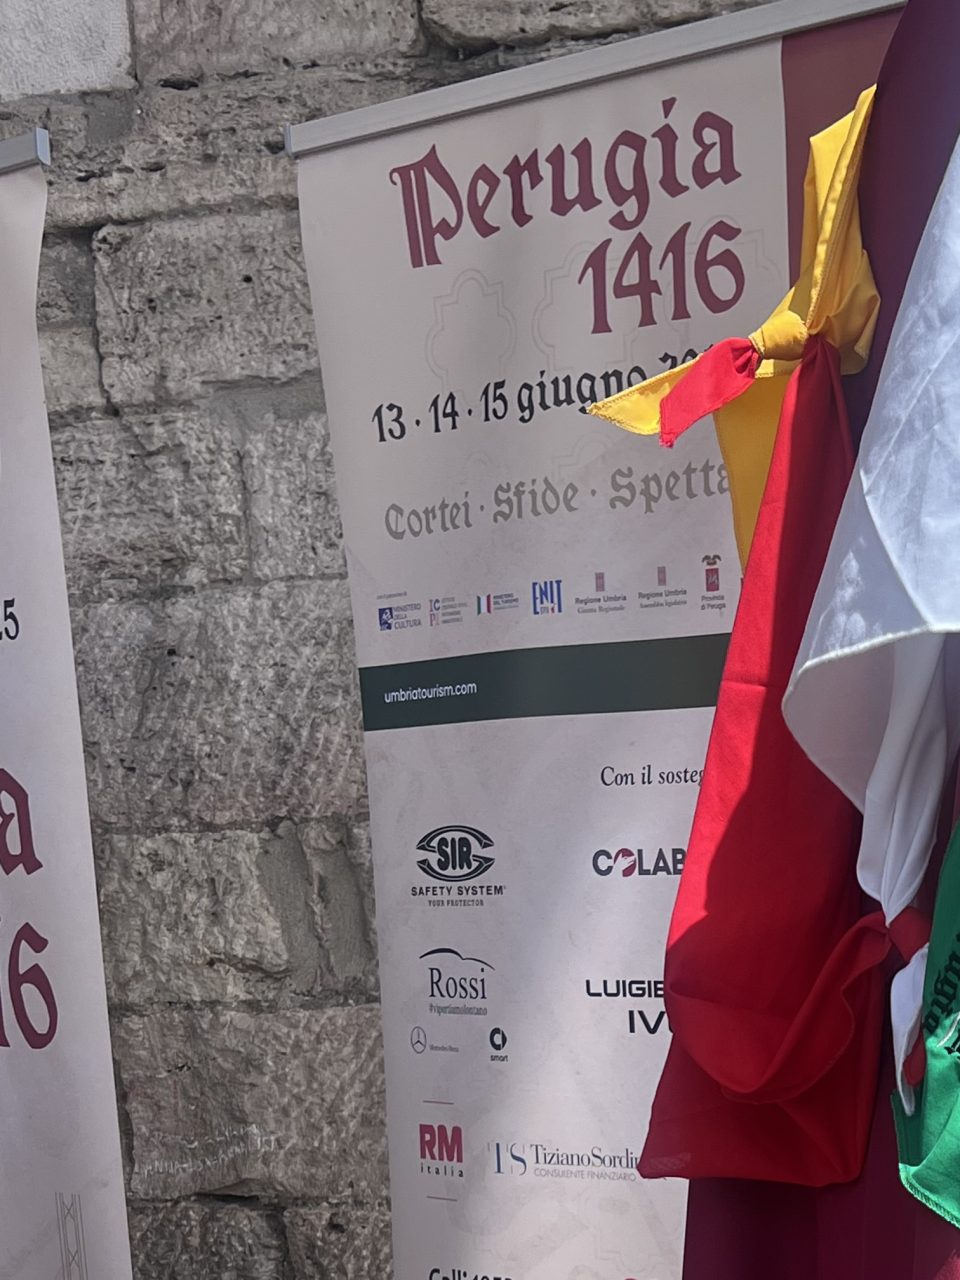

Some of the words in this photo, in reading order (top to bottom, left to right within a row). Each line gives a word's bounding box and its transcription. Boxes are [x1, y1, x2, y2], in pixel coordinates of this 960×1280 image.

[389, 97, 742, 268] Perugia
[578, 220, 745, 334] 1416
[384, 491, 472, 541] Cortei
[493, 476, 579, 525] Sfide
[532, 580, 562, 615] ENIT
[394, 619, 421, 630] CULTURA
[384, 681, 477, 704] umbriatourism.com
[600, 765, 635, 786] Con
[641, 764, 653, 785] il
[437, 837, 473, 871] SIR
[411, 886, 452, 897] SAFETY
[428, 967, 487, 1000] Rossi
[419, 1124, 463, 1163] RM
[420, 1162, 464, 1178] italia
